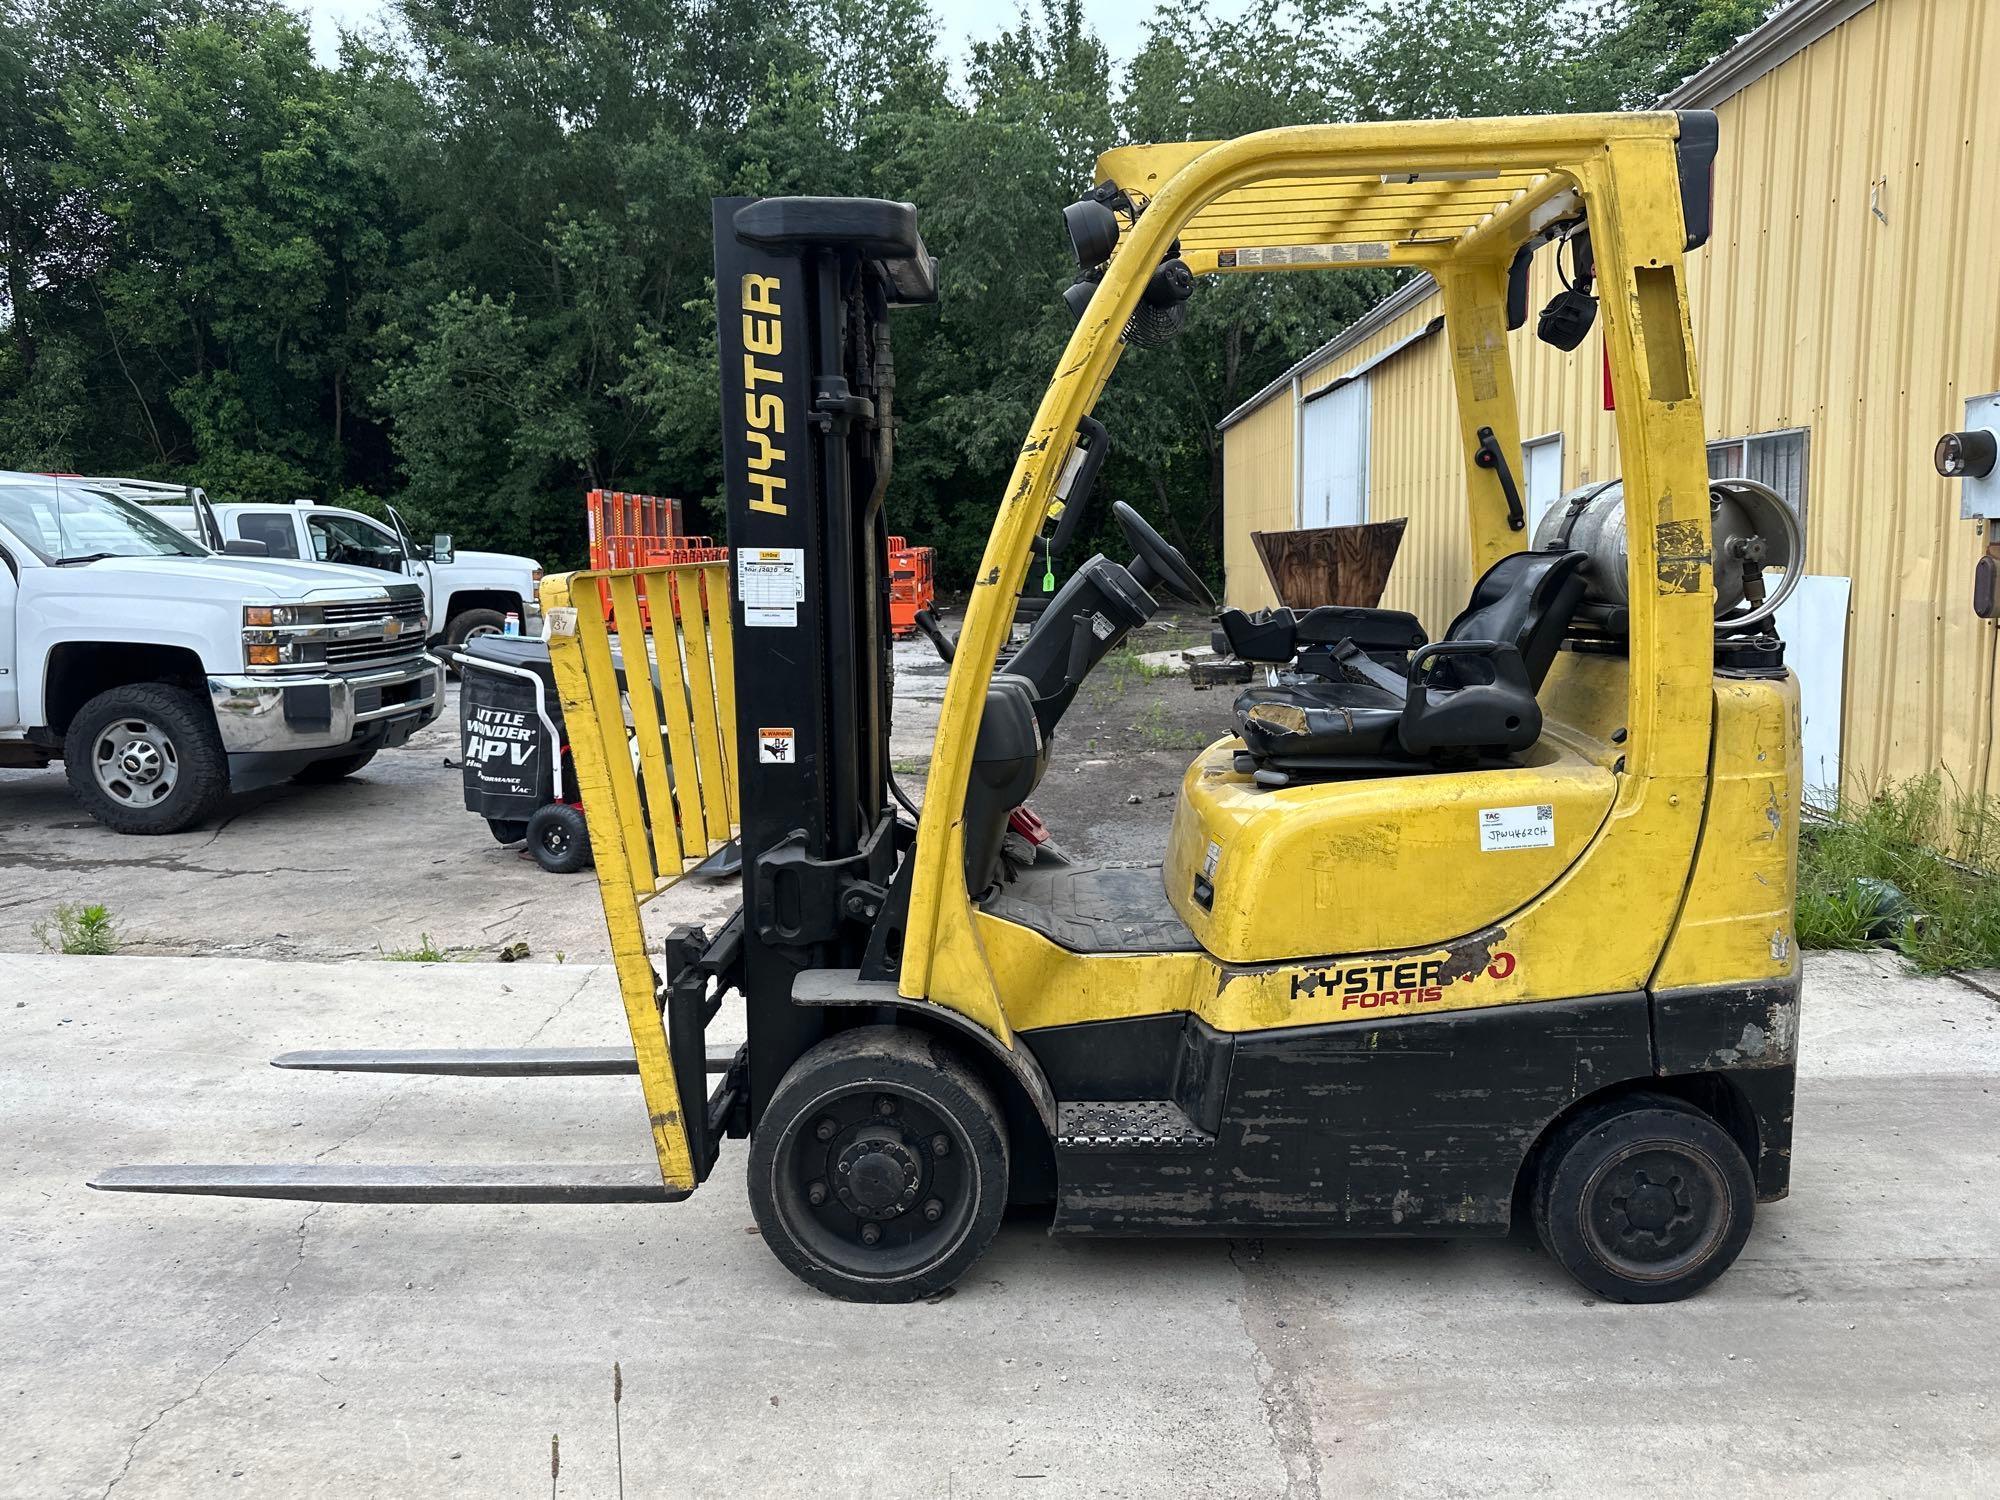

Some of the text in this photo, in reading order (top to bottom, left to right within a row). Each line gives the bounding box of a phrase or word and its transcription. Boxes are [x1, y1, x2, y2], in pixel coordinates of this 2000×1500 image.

[742, 273, 787, 516] HYSTER
[476, 707, 526, 727] LITTLE
[465, 735, 537, 766] HPV
[1341, 985, 1443, 1010] FORTIS
